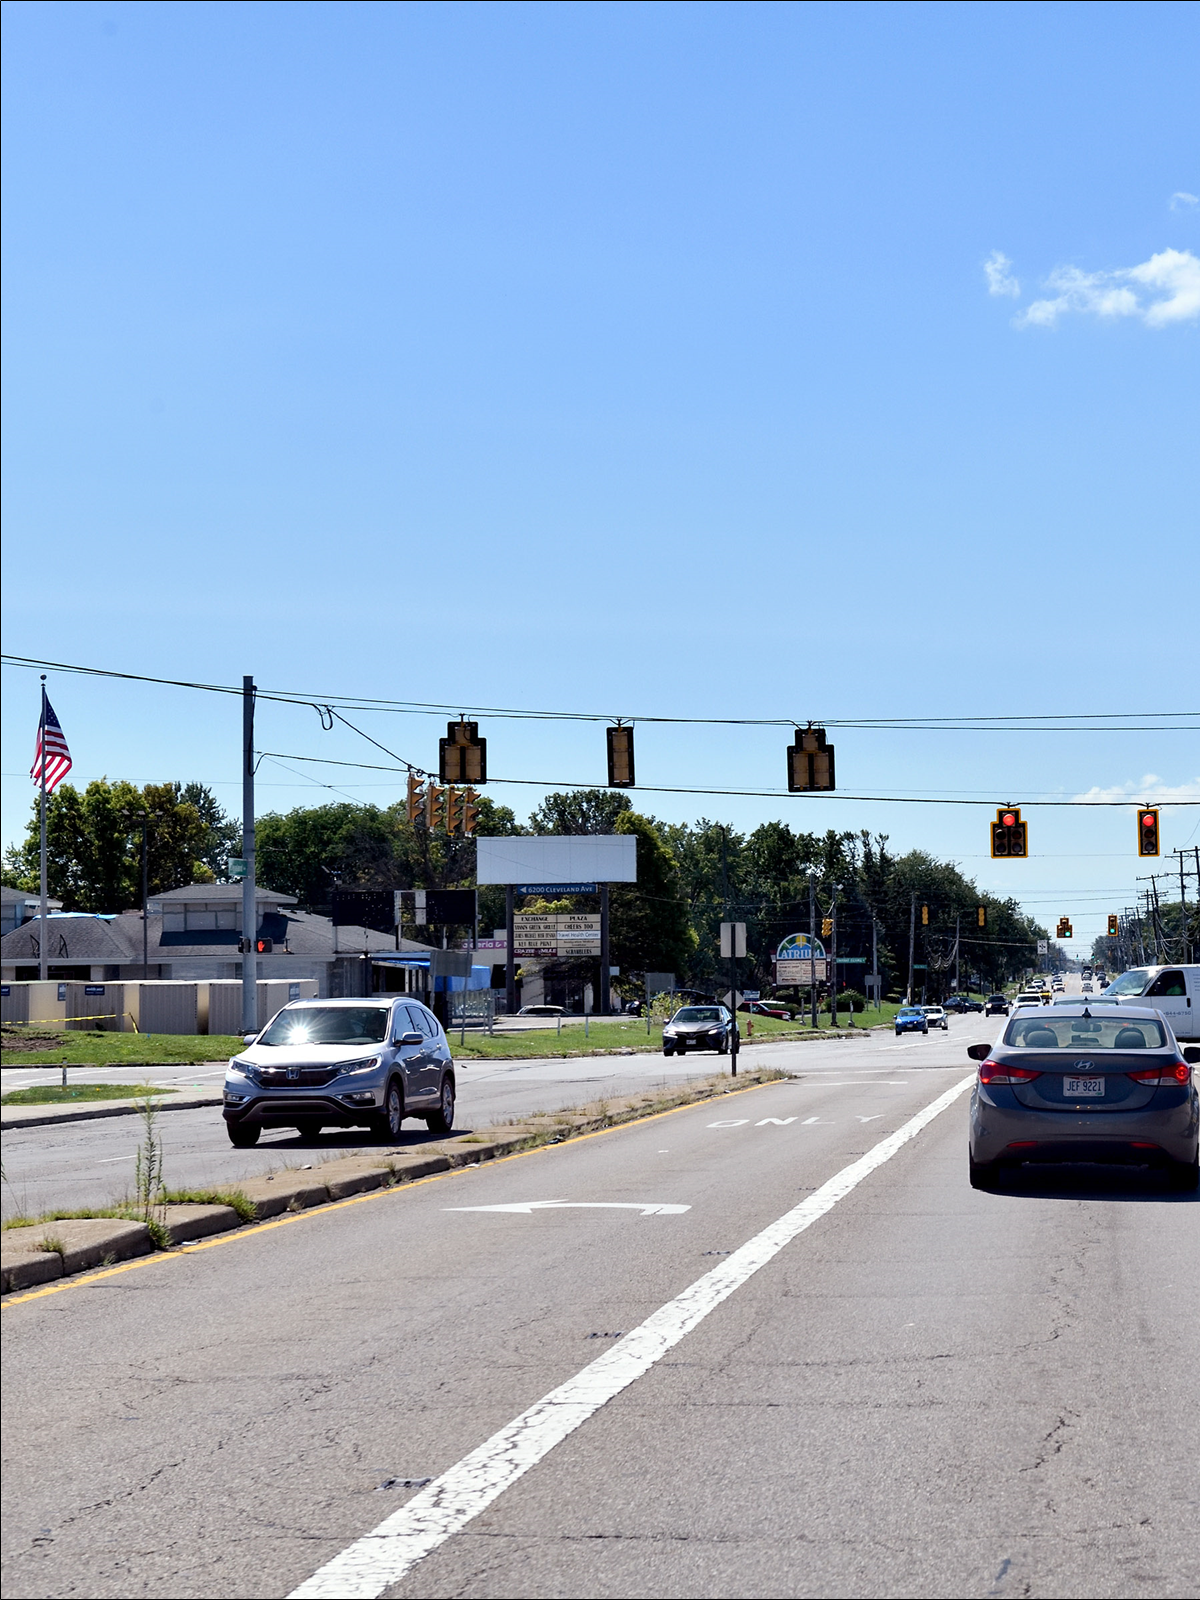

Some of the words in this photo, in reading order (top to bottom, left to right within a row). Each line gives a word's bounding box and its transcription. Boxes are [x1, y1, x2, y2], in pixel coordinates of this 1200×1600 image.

[781, 949, 820, 959] ATRIUM
[1067, 1081, 1080, 1091] JEF
[1083, 1081, 1101, 1091] 9221
[706, 1114, 886, 1128] ONLY
